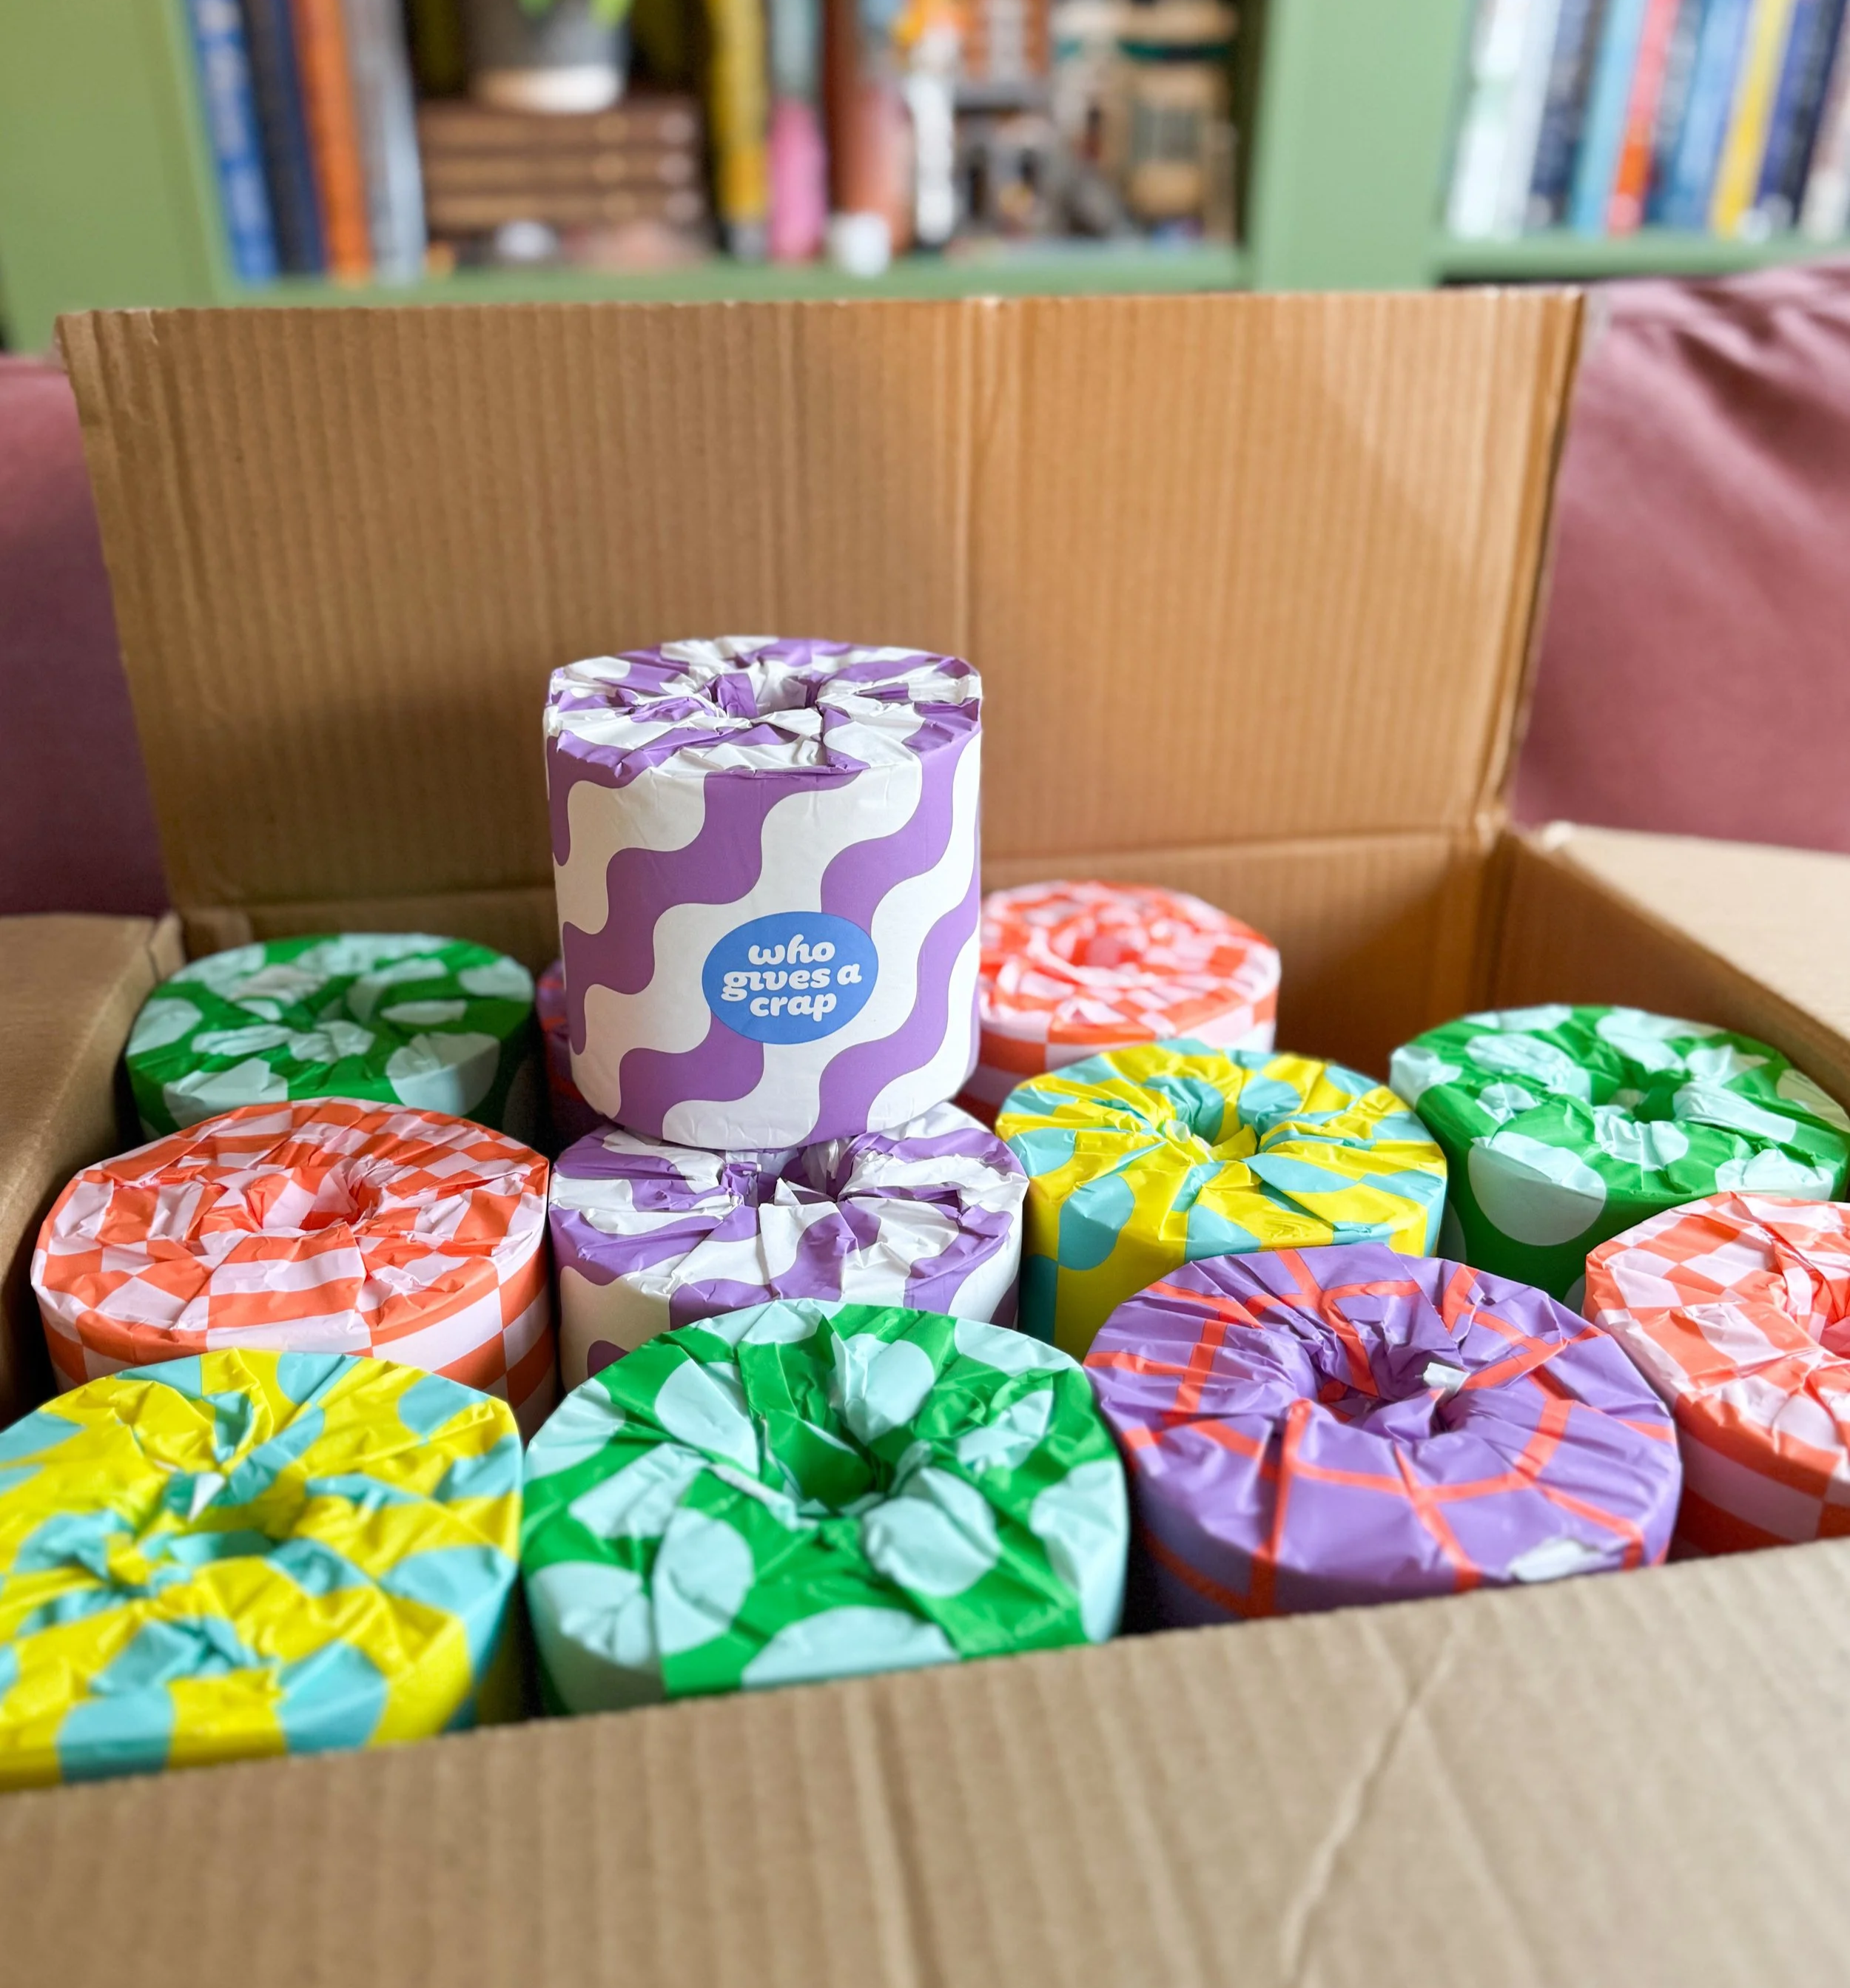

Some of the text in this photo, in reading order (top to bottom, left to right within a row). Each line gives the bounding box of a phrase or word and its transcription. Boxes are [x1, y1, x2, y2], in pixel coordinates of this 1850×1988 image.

[748, 934, 835, 965] who
[721, 963, 862, 1001] gives a
[750, 993, 837, 1022] crap
